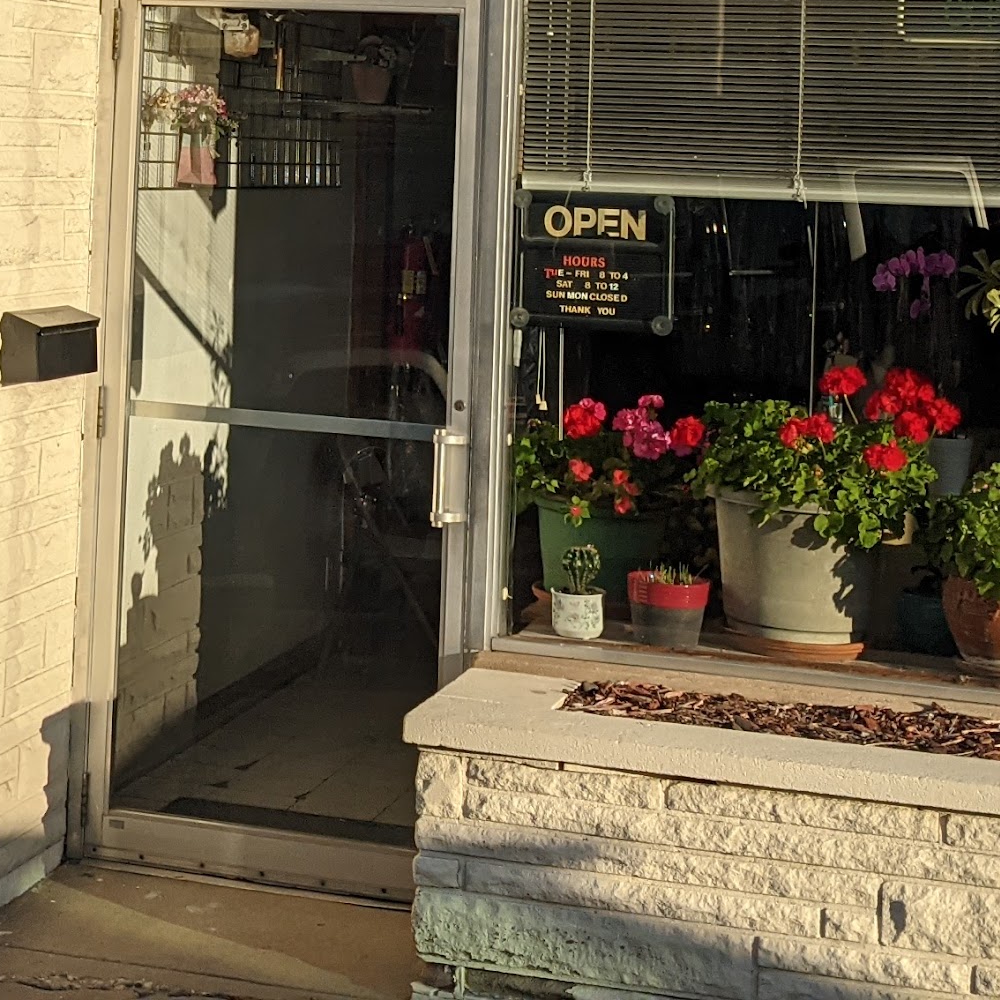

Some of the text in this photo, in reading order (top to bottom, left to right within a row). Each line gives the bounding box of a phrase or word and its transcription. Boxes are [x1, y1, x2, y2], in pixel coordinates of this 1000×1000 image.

[544, 205, 647, 240] OPEN
[563, 255, 606, 268] HOURS
[575, 270, 590, 278] FRI
[599, 271, 606, 279] 8
[609, 271, 621, 280] TO
[622, 272, 629, 280] 4
[556, 280, 573, 288] SAT
[595, 282, 607, 290] TO
[609, 283, 619, 291] 12
[546, 290, 628, 302] SUN MON CLOSED
[559, 305, 616, 315] THANK YOU
